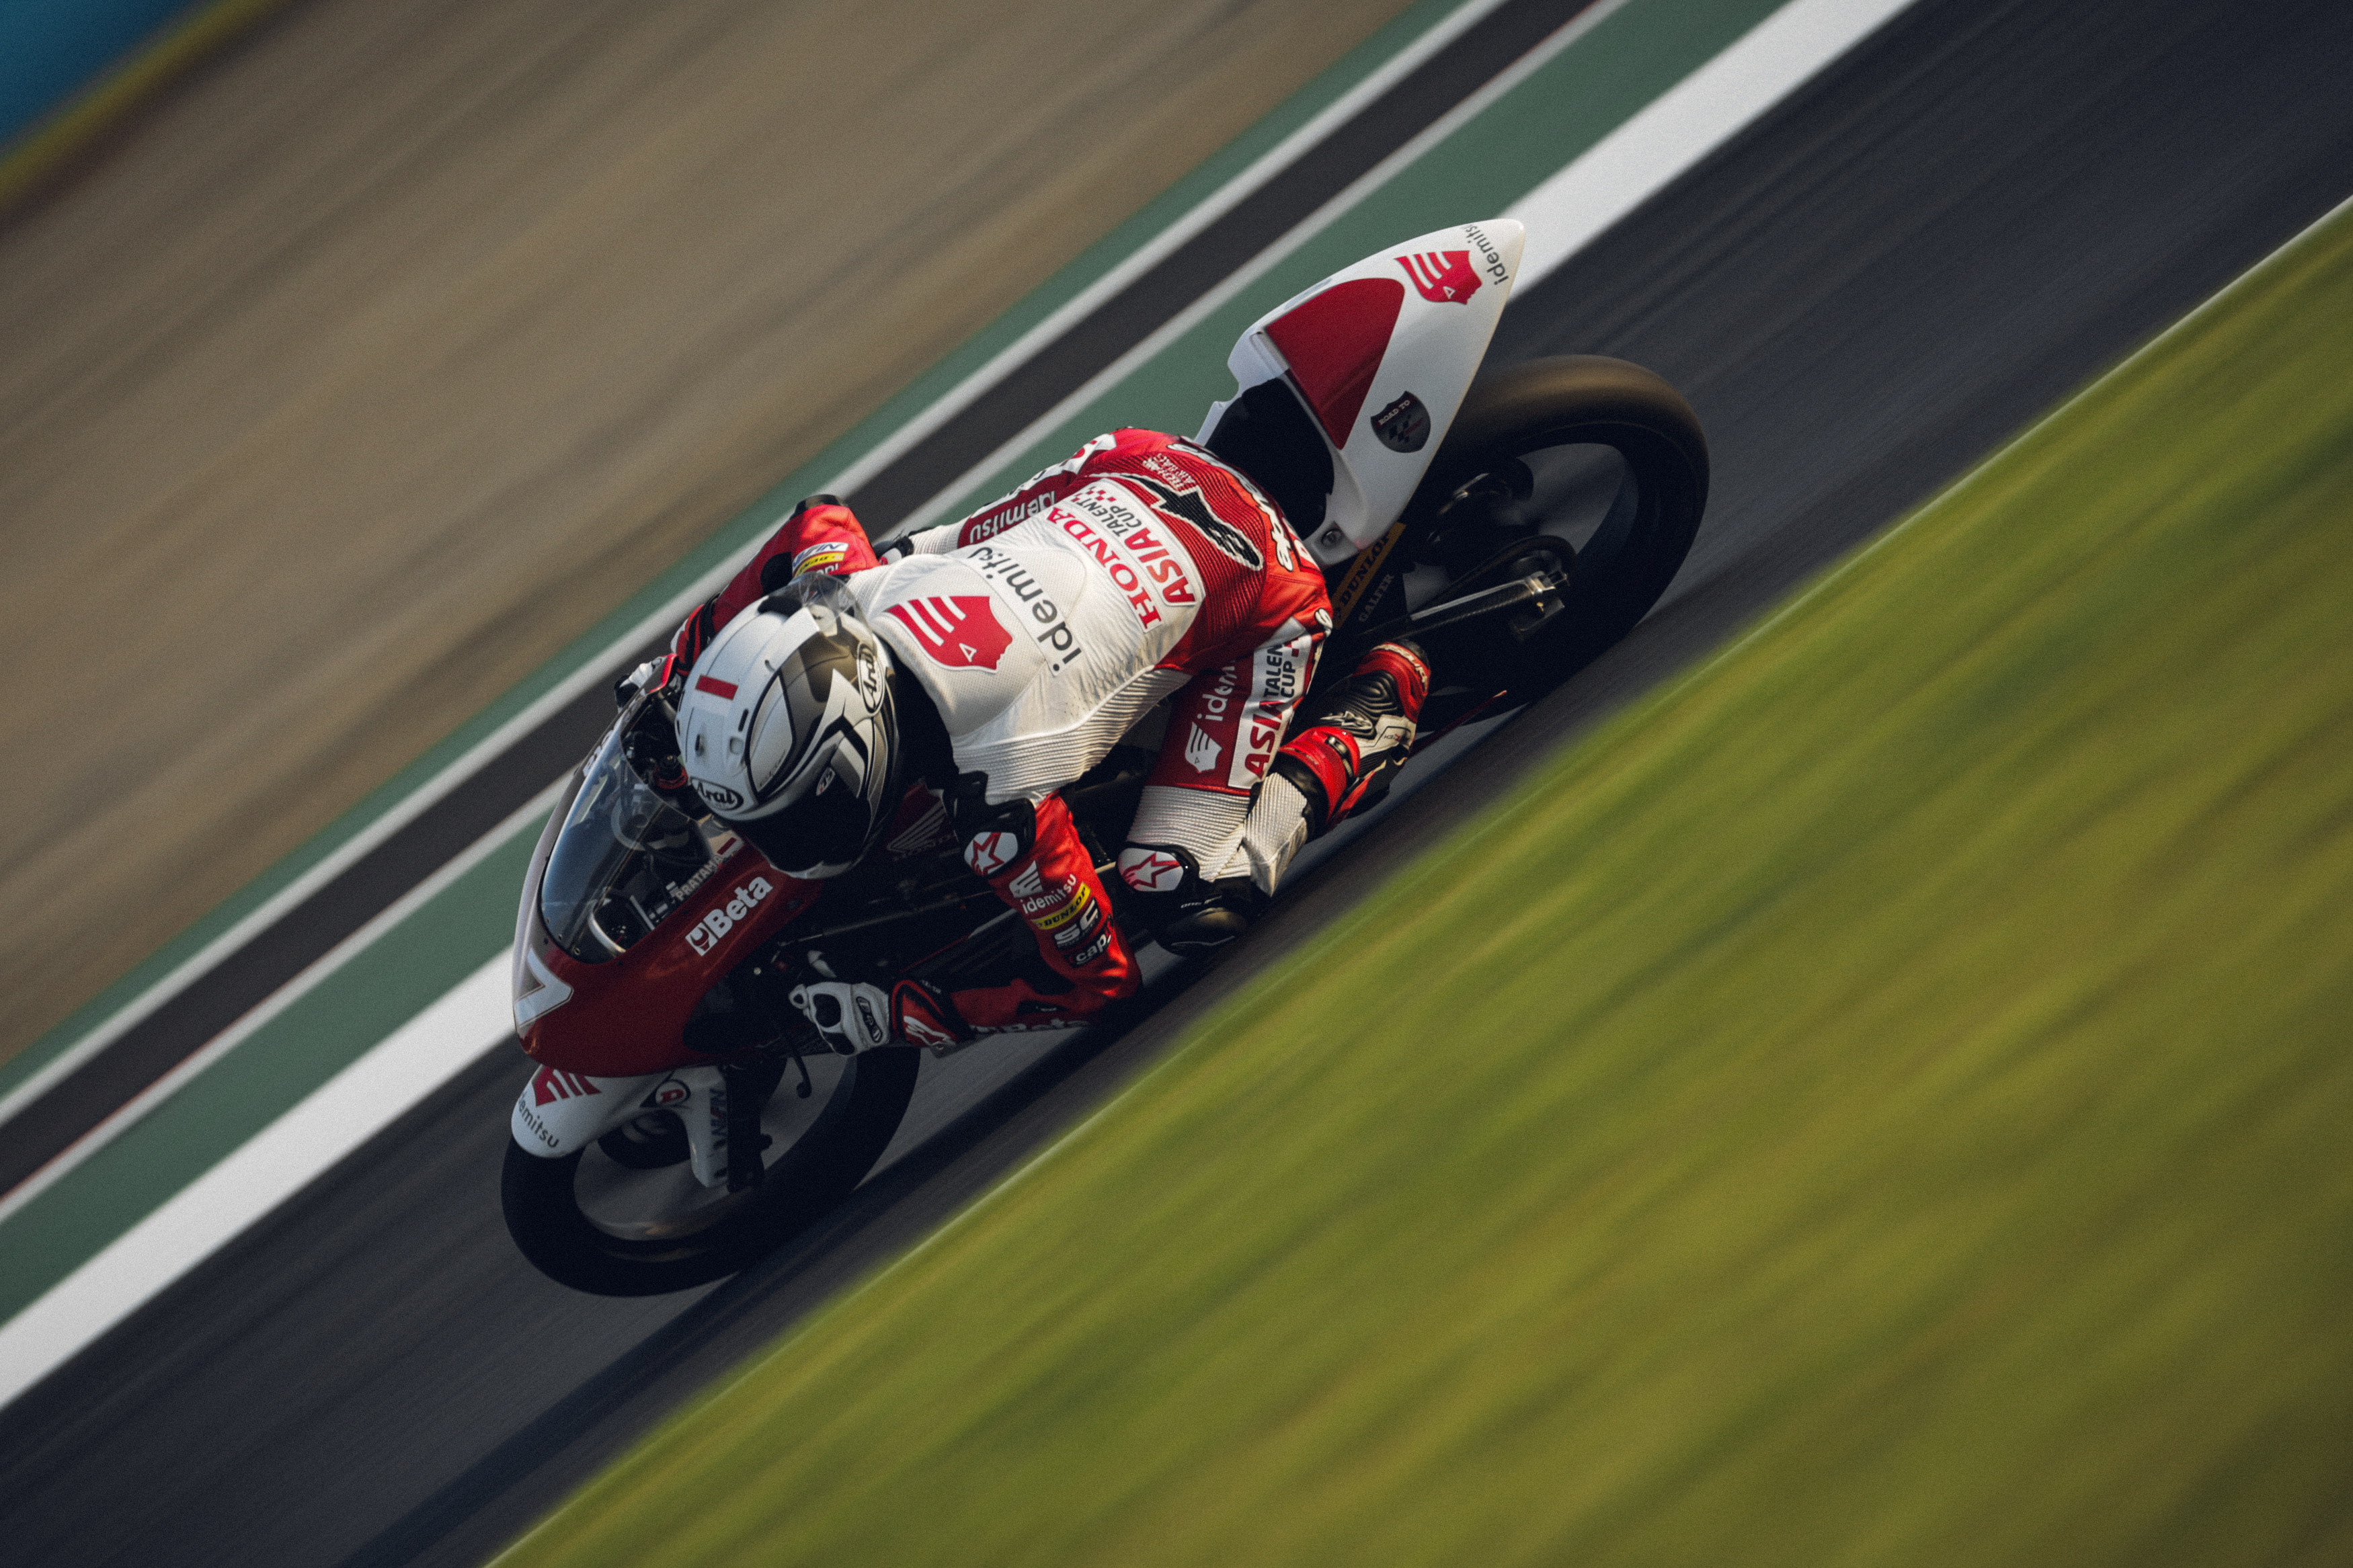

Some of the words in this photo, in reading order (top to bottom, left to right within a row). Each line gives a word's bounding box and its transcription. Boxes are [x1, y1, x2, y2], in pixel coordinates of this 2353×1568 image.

[1378, 407, 1400, 425] ROAD
[1398, 399, 1411, 410] TO
[1076, 498, 1127, 537] TALENT
[1110, 505, 1143, 530] CUP
[1046, 506, 1162, 629] HONDA
[1124, 526, 1196, 604] ASIA
[967, 546, 1081, 673] idemitsu
[1358, 573, 1395, 622] GALFER
[859, 650, 876, 708] Arai
[1197, 659, 1238, 722] idem
[1280, 660, 1296, 698] CUP
[695, 781, 735, 806] Arai
[675, 855, 723, 901] PRATAMA
[1019, 873, 1077, 915] idemitsu
[703, 876, 774, 939] Beta
[1043, 886, 1087, 927] DUNLOP
[519, 1094, 561, 1149] emitsu
